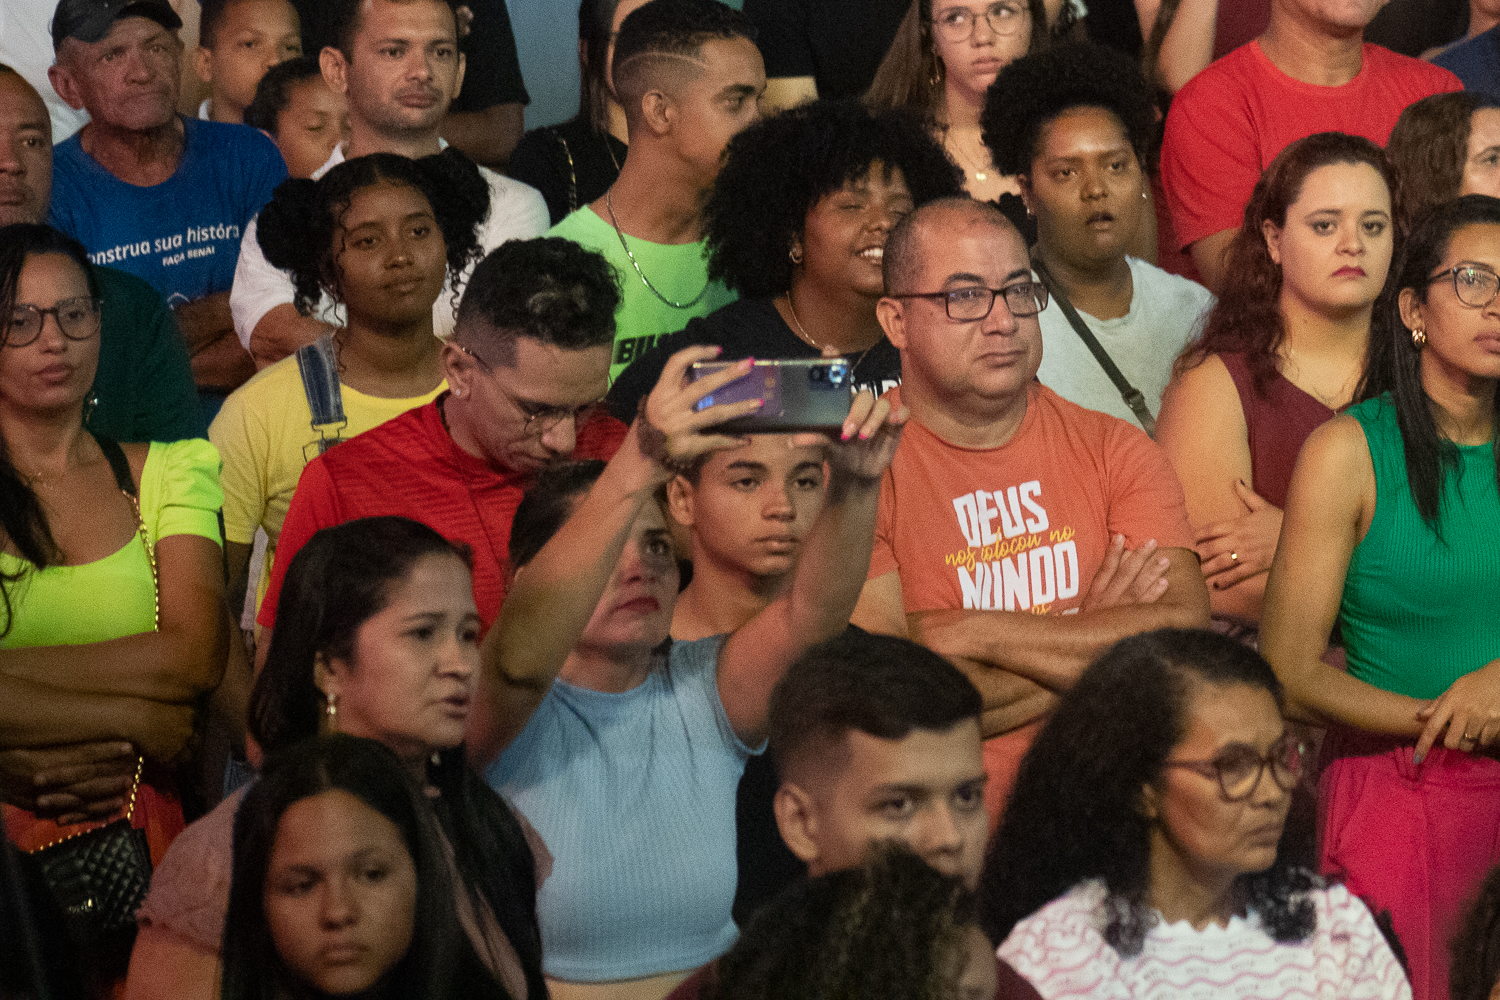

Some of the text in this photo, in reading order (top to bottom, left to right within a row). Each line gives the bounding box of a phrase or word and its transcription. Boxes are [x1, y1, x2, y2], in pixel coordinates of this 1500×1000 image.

[87, 240, 150, 265] onstrua
[154, 234, 183, 252] sua
[162, 246, 216, 267] FAÇA SENAI
[952, 479, 1049, 548] DEUS
[1050, 525, 1076, 542] no
[957, 539, 1080, 612] MUNDO
